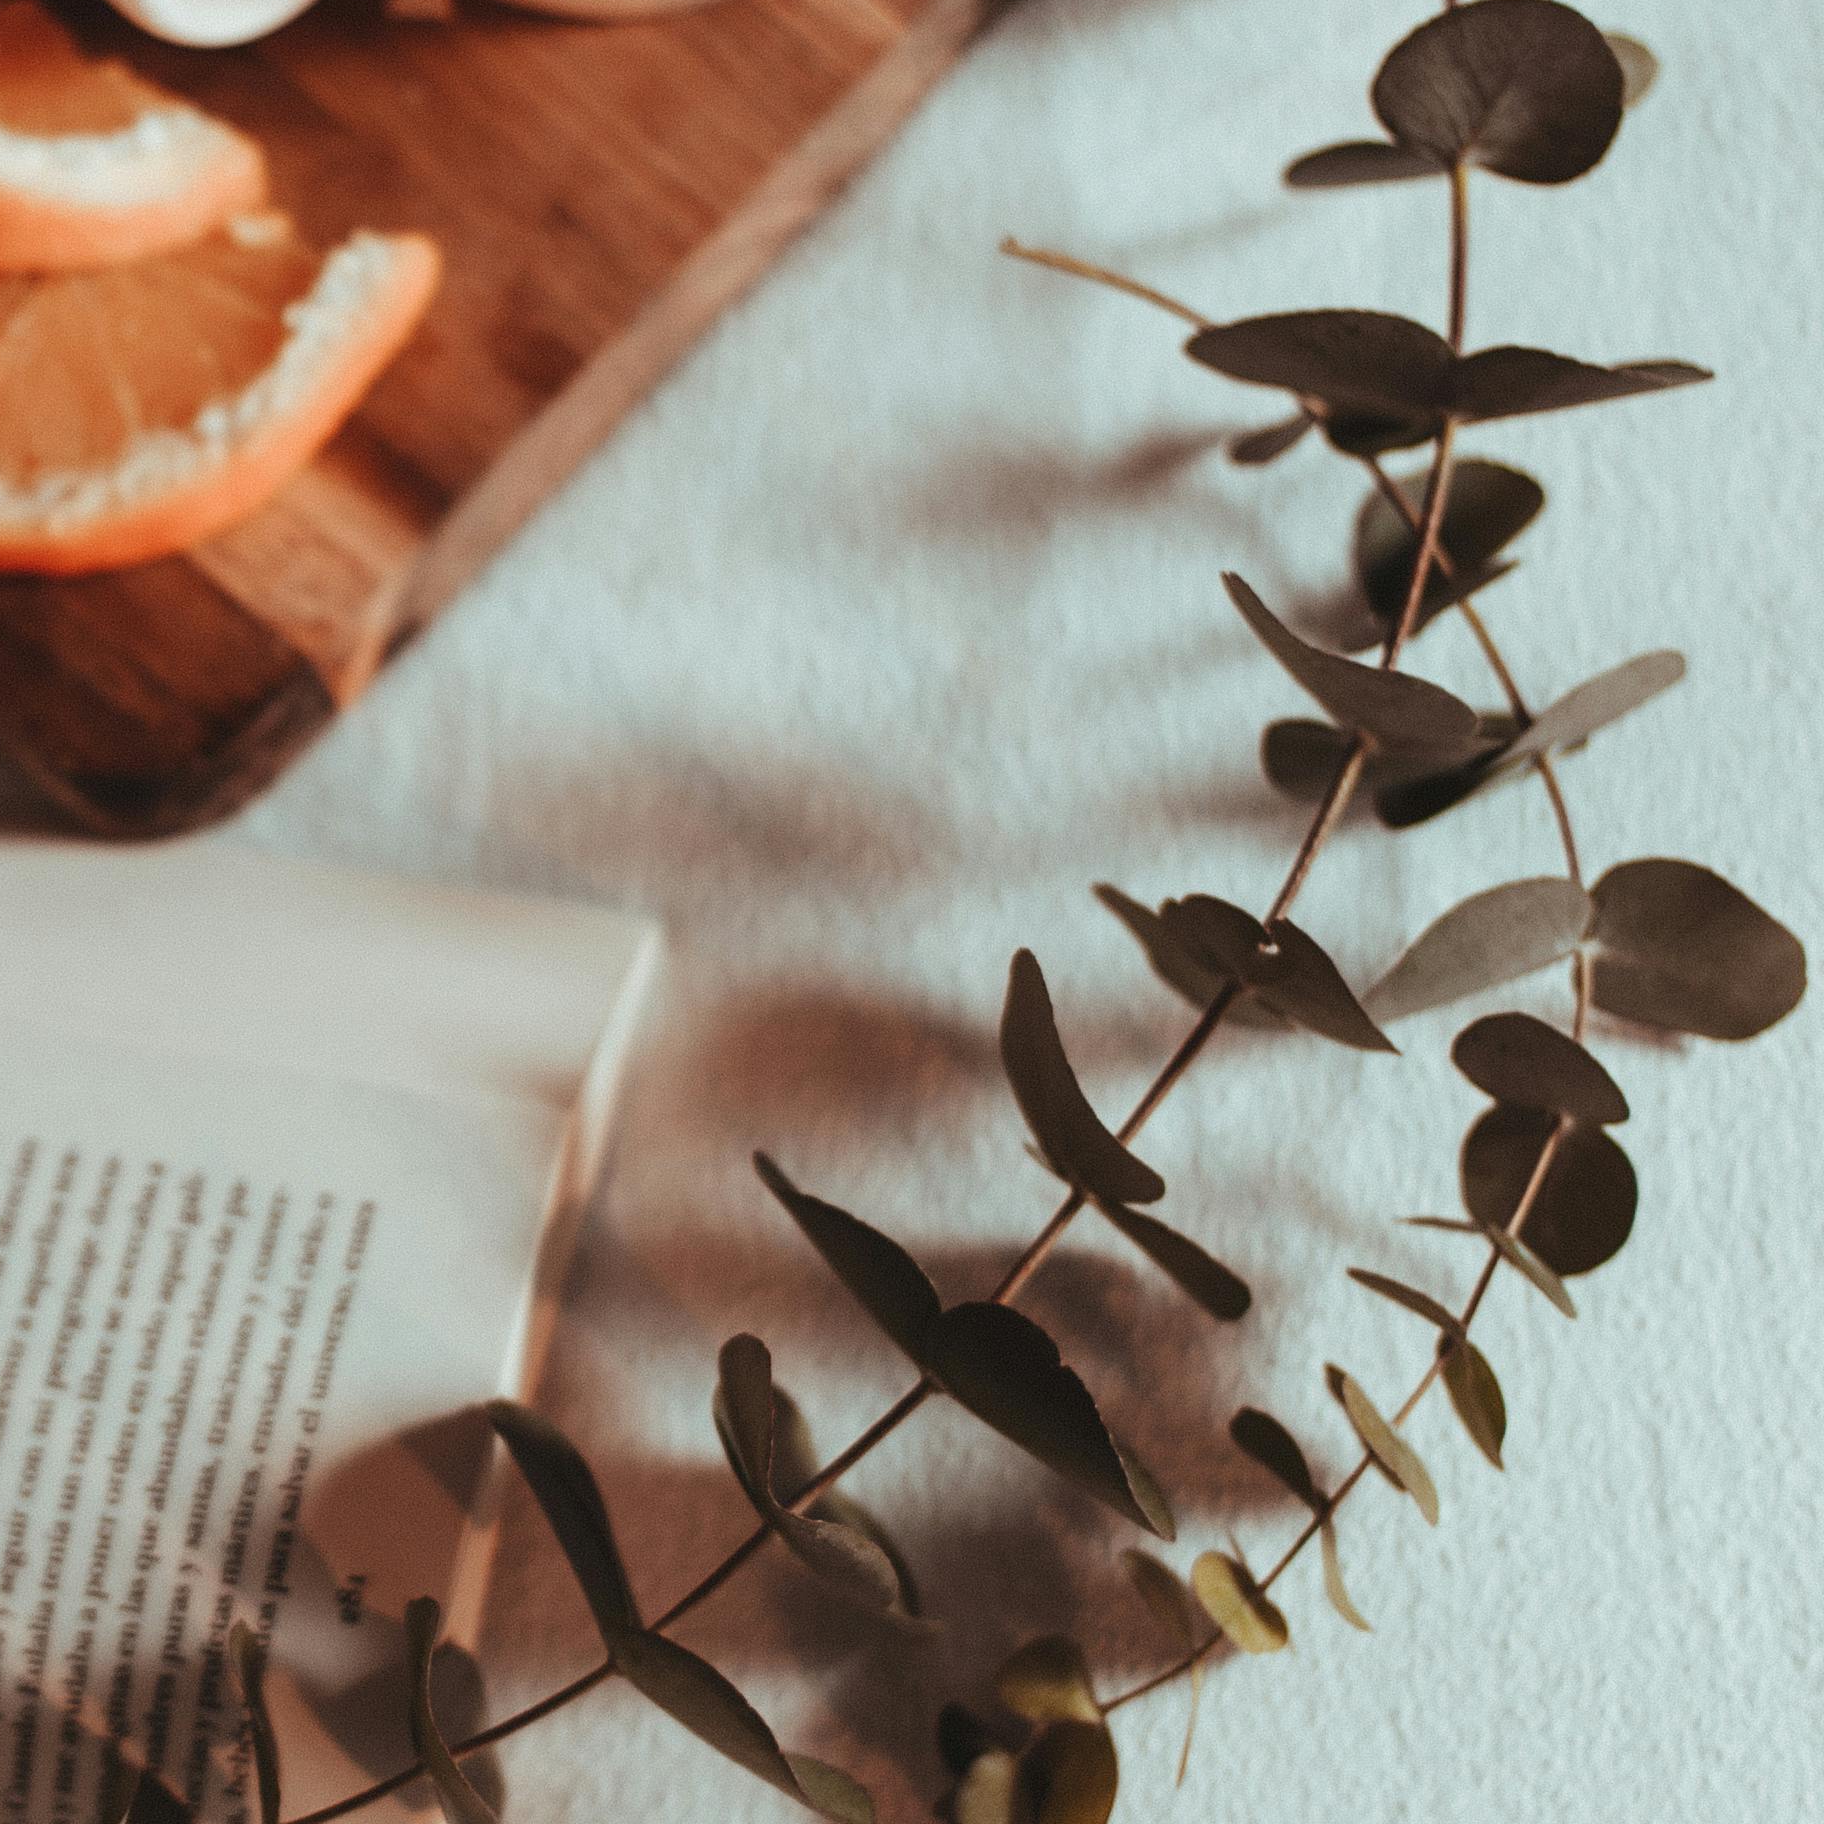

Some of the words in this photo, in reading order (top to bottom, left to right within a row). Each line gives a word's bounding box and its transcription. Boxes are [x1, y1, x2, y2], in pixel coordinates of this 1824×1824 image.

[187, 1262, 227, 1348] relatos
[17, 1445, 45, 1498] con
[44, 1238, 102, 1390] peregrinaje
[77, 1341, 116, 1402] libre
[203, 1314, 257, 1447] traiciones
[68, 1408, 98, 1465] rato
[84, 1513, 118, 1600] poner
[104, 1422, 139, 1506] orden
[132, 1313, 168, 1372] todo
[144, 1360, 200, 1513] abundaban
[220, 1467, 268, 1585] mártires,
[250, 1335, 297, 1457] enviados
[276, 1287, 309, 1328] del
[135, 1523, 161, 1572] que
[185, 1457, 226, 1550] santas,
[265, 1529, 295, 1594] para
[280, 1443, 315, 1521] salvar
[37, 1517, 73, 1593] tenía
[119, 1574, 150, 1615] las
[162, 1584, 194, 1662] puras
